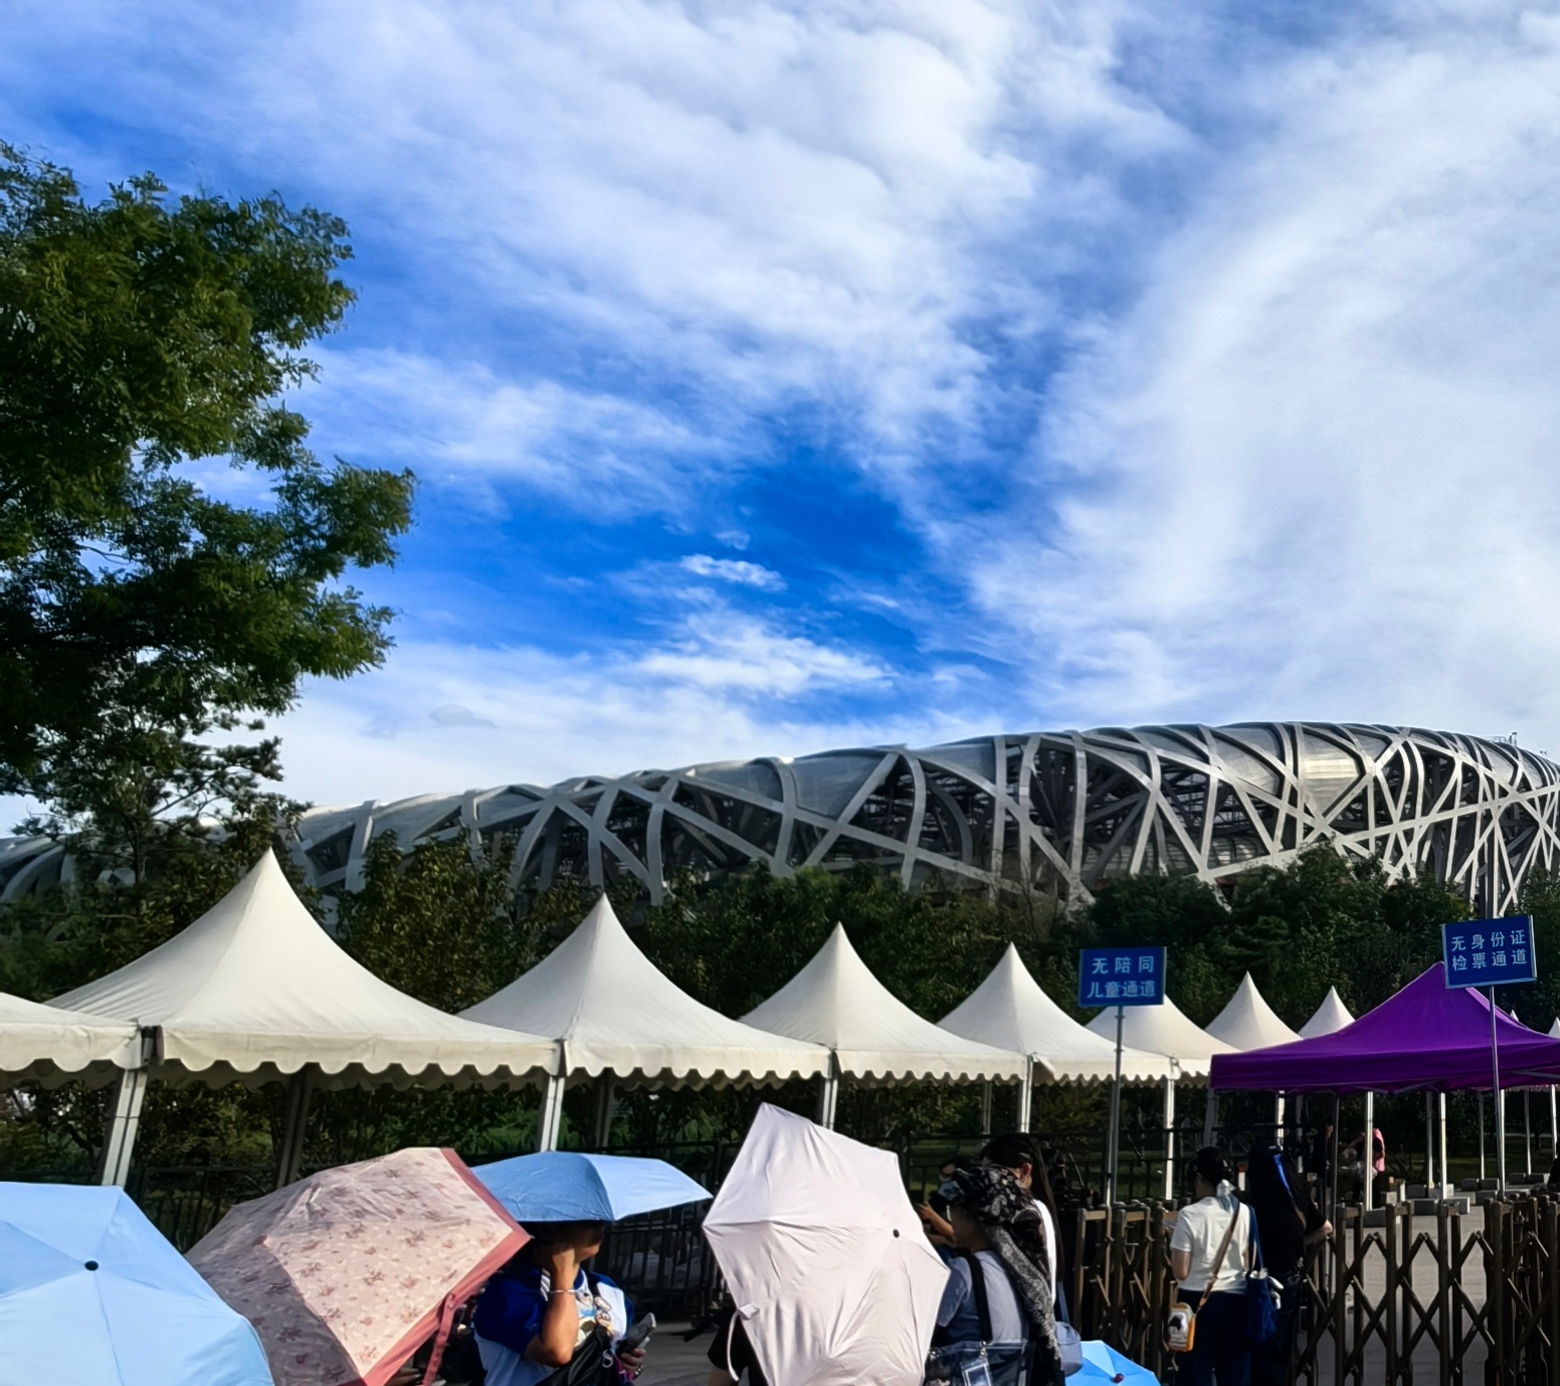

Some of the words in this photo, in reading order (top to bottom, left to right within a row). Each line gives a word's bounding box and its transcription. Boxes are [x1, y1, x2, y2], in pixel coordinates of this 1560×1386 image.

[1451, 929, 1526, 952] 无身份证
[1091, 955, 1154, 975] 无陪同
[1452, 948, 1528, 971] 检票通道
[1086, 979, 1157, 999] 儿童通道
